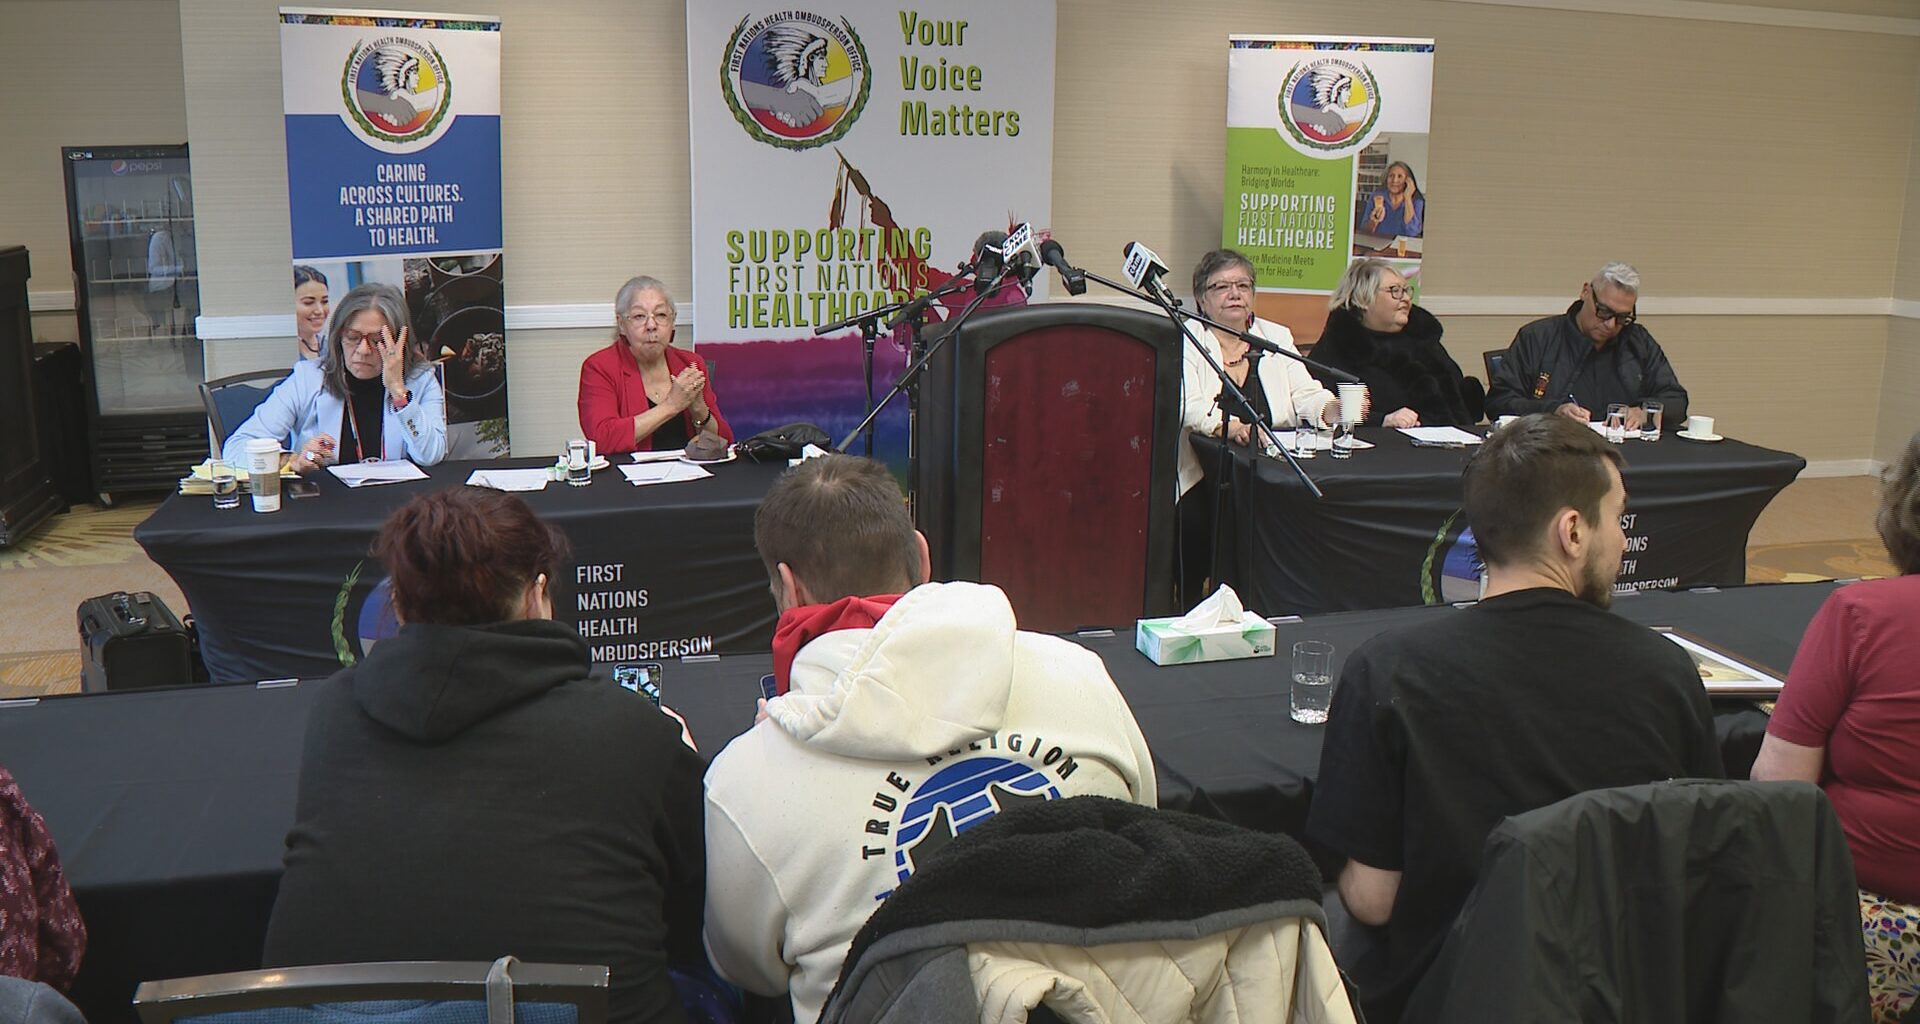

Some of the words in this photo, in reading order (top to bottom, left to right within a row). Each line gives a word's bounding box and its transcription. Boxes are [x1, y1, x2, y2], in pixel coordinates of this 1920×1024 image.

[899, 10, 968, 46] Your
[373, 37, 394, 49] HEALTH
[730, 50, 742, 73] FIRST
[738, 22, 765, 49] NATIONS
[764, 11, 793, 26] HEALTH
[795, 11, 850, 47] OMBUDSPERSON
[846, 45, 862, 72] OFFICE
[899, 56, 982, 91] Voice
[900, 100, 1020, 137] Matters
[129, 161, 162, 172] pepsi
[377, 163, 426, 183] CARING
[1241, 164, 1272, 177] Harmony
[1241, 176, 1270, 189] Bridging
[1271, 177, 1295, 188] Worlds
[340, 185, 393, 205] ACROSS
[396, 184, 464, 203] CULTURES.
[1240, 192, 1335, 213] SUPPORTING
[355, 207, 364, 226] A
[366, 206, 418, 225] SHARED
[421, 205, 453, 223] PATH
[1240, 210, 1275, 227] FIRST
[1280, 213, 1334, 229] NATIONS
[369, 228, 386, 247] TO
[388, 226, 439, 246] HEALTH.
[726, 227, 932, 263] SUPPORTING
[1238, 227, 1334, 249] HEALTHCARE
[1261, 253, 1292, 265] Medicine
[1293, 254, 1314, 266] Meets
[729, 263, 804, 293] FIRST
[817, 261, 930, 291] NATIONS
[1266, 265, 1276, 276] for
[576, 563, 624, 583] FIRST
[577, 589, 648, 611] NATIONS
[578, 617, 638, 637] HEALTH
[591, 635, 712, 662] MBUDSPERSON
[862, 771, 911, 860] TRUE
